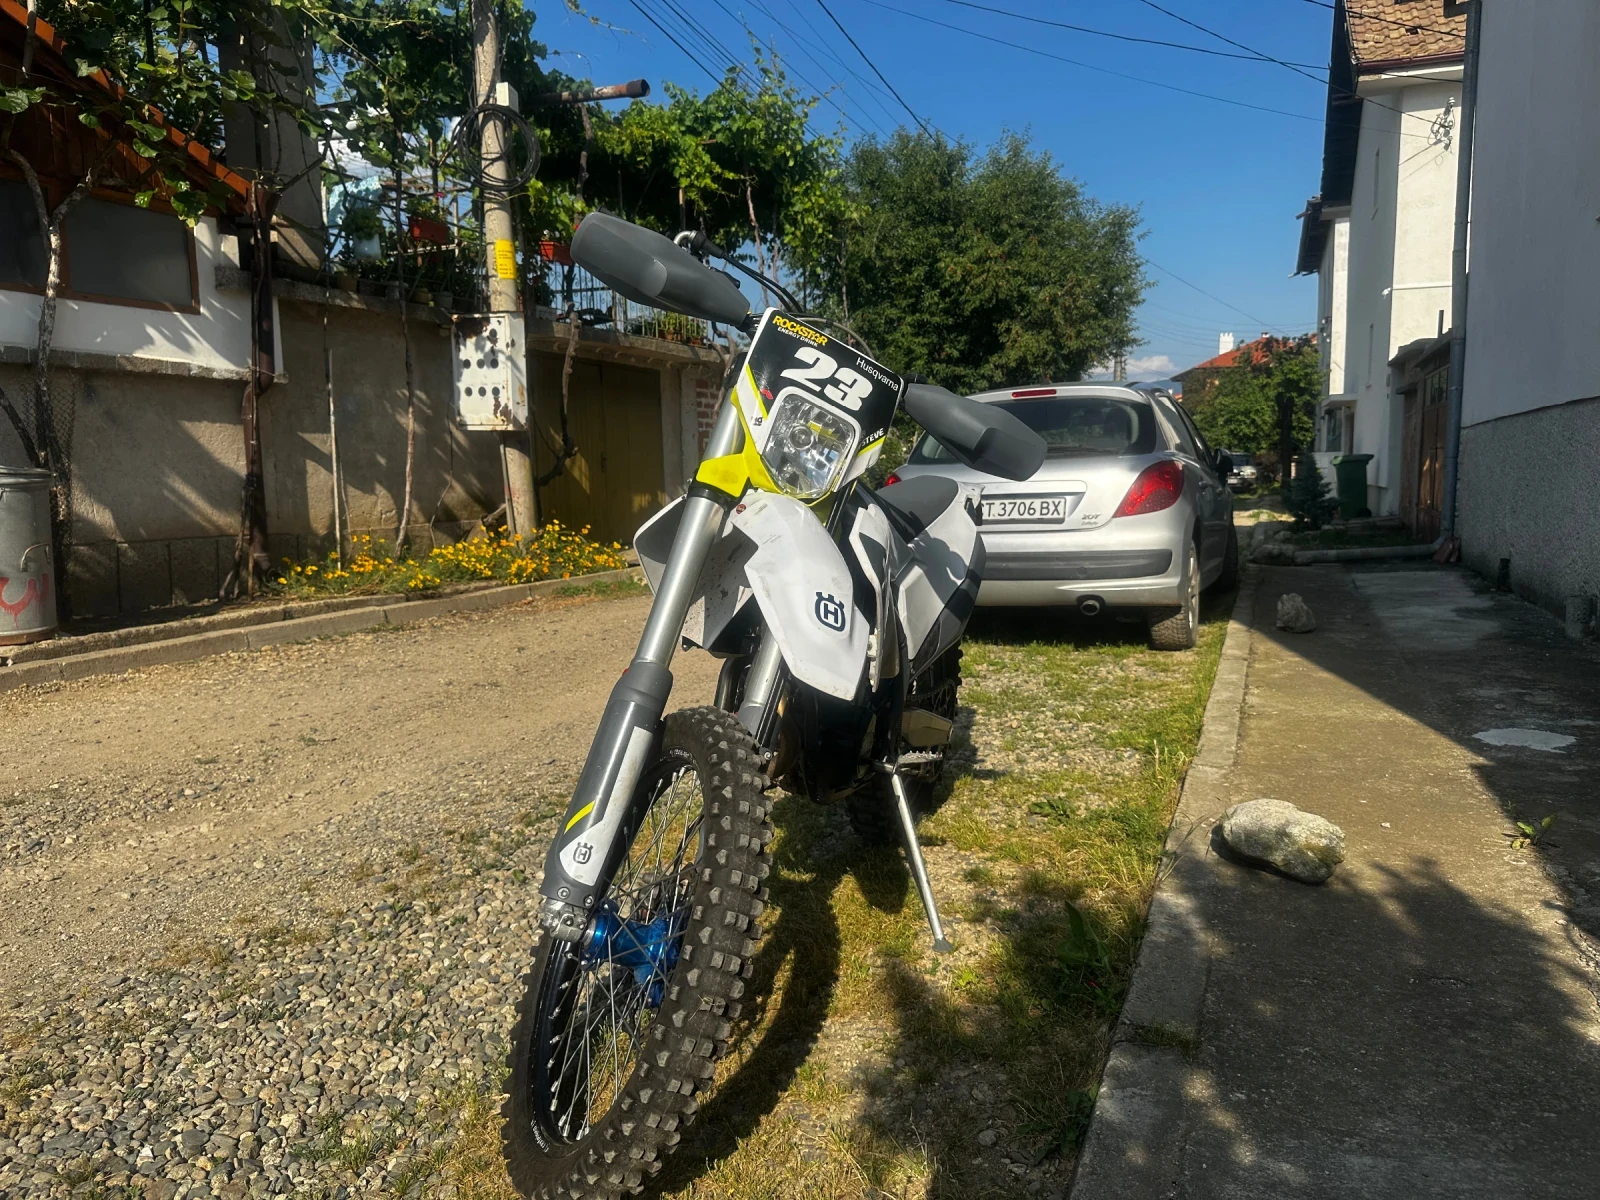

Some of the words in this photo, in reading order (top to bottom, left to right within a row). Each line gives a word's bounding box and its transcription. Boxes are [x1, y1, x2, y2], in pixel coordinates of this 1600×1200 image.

[772, 315, 828, 346] ROCKSTAR
[777, 326, 801, 340] ENERGY
[799, 336, 818, 347] DRINK
[780, 346, 873, 411] 23
[856, 357, 899, 391] Husqvarna
[997, 501, 1037, 517] 3706
[1039, 500, 1062, 516] BX
